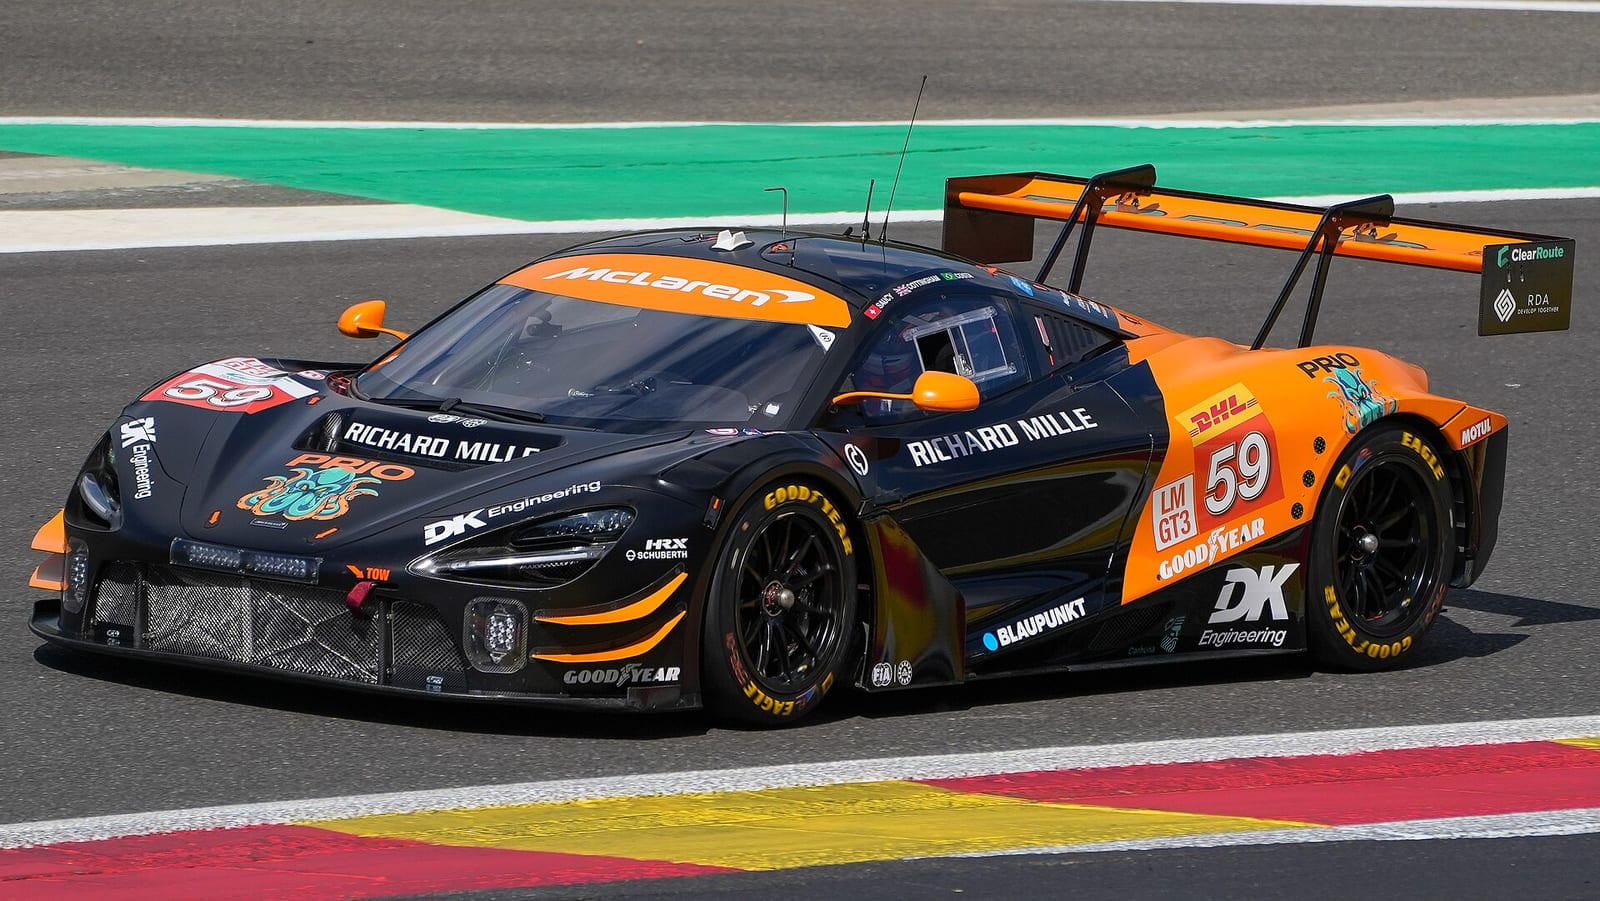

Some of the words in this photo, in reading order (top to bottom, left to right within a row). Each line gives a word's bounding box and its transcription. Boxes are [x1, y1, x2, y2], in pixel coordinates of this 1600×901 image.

[1511, 246, 1564, 261] ClearRoute
[543, 267, 770, 306] McLaren
[876, 293, 894, 309] SAUCY
[1527, 294, 1549, 306] RDA
[1537, 306, 1559, 314] TOGETHER
[1297, 352, 1361, 379] PRIO
[162, 379, 273, 406] 59
[1190, 395, 1247, 433] DHL
[120, 416, 157, 450] DK
[344, 422, 450, 458] RICHARD
[907, 423, 1019, 467] RICHARD
[1018, 407, 1098, 442] MILLE
[1461, 418, 1492, 446] MOTUL
[285, 453, 416, 481] PRIO
[1401, 431, 1445, 481] EAGLE
[129, 443, 155, 500] Engineering
[1203, 430, 1272, 517] 59
[424, 508, 487, 546] DK
[487, 481, 601, 518] Engineering
[1160, 484, 1187, 515] LM
[1158, 508, 1192, 538] GT3
[637, 549, 688, 560] SCHUBERTH
[645, 538, 689, 550] HRX
[1158, 517, 1266, 581] GOODYEAR
[365, 567, 390, 581] TOW
[1208, 562, 1300, 624] DK
[996, 597, 1088, 647] BLAUPUNKT
[1198, 628, 1287, 647] Engineering
[563, 664, 681, 686] GOODYEAR
[743, 678, 794, 716] EAGLE
